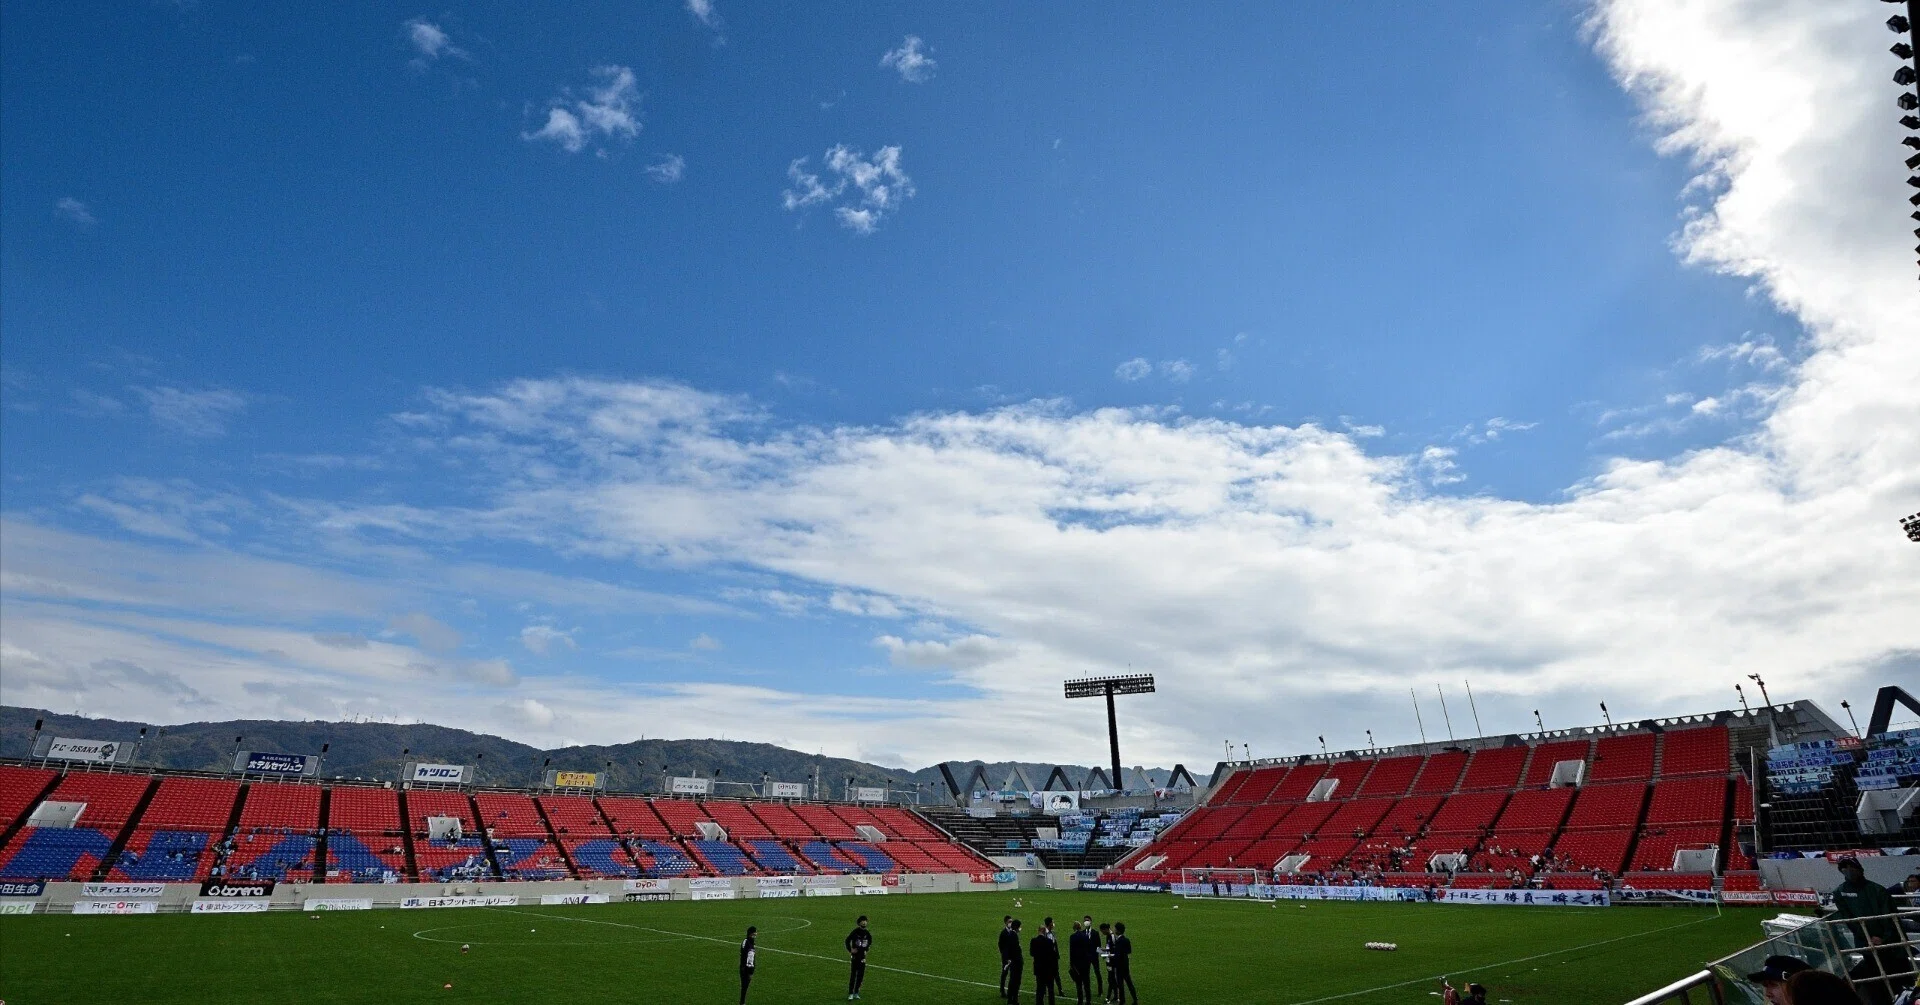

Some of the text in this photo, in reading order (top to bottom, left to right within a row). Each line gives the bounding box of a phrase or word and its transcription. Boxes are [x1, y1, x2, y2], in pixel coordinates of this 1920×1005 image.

[70, 745, 99, 754] OSAKA
[247, 760, 304, 772] ホテルセイリュウ
[418, 767, 460, 777] カツロン
[0, 883, 40, 894] 田生命
[403, 897, 516, 907] JFL 日本フットボールリーグ
[561, 896, 580, 904] ANA
